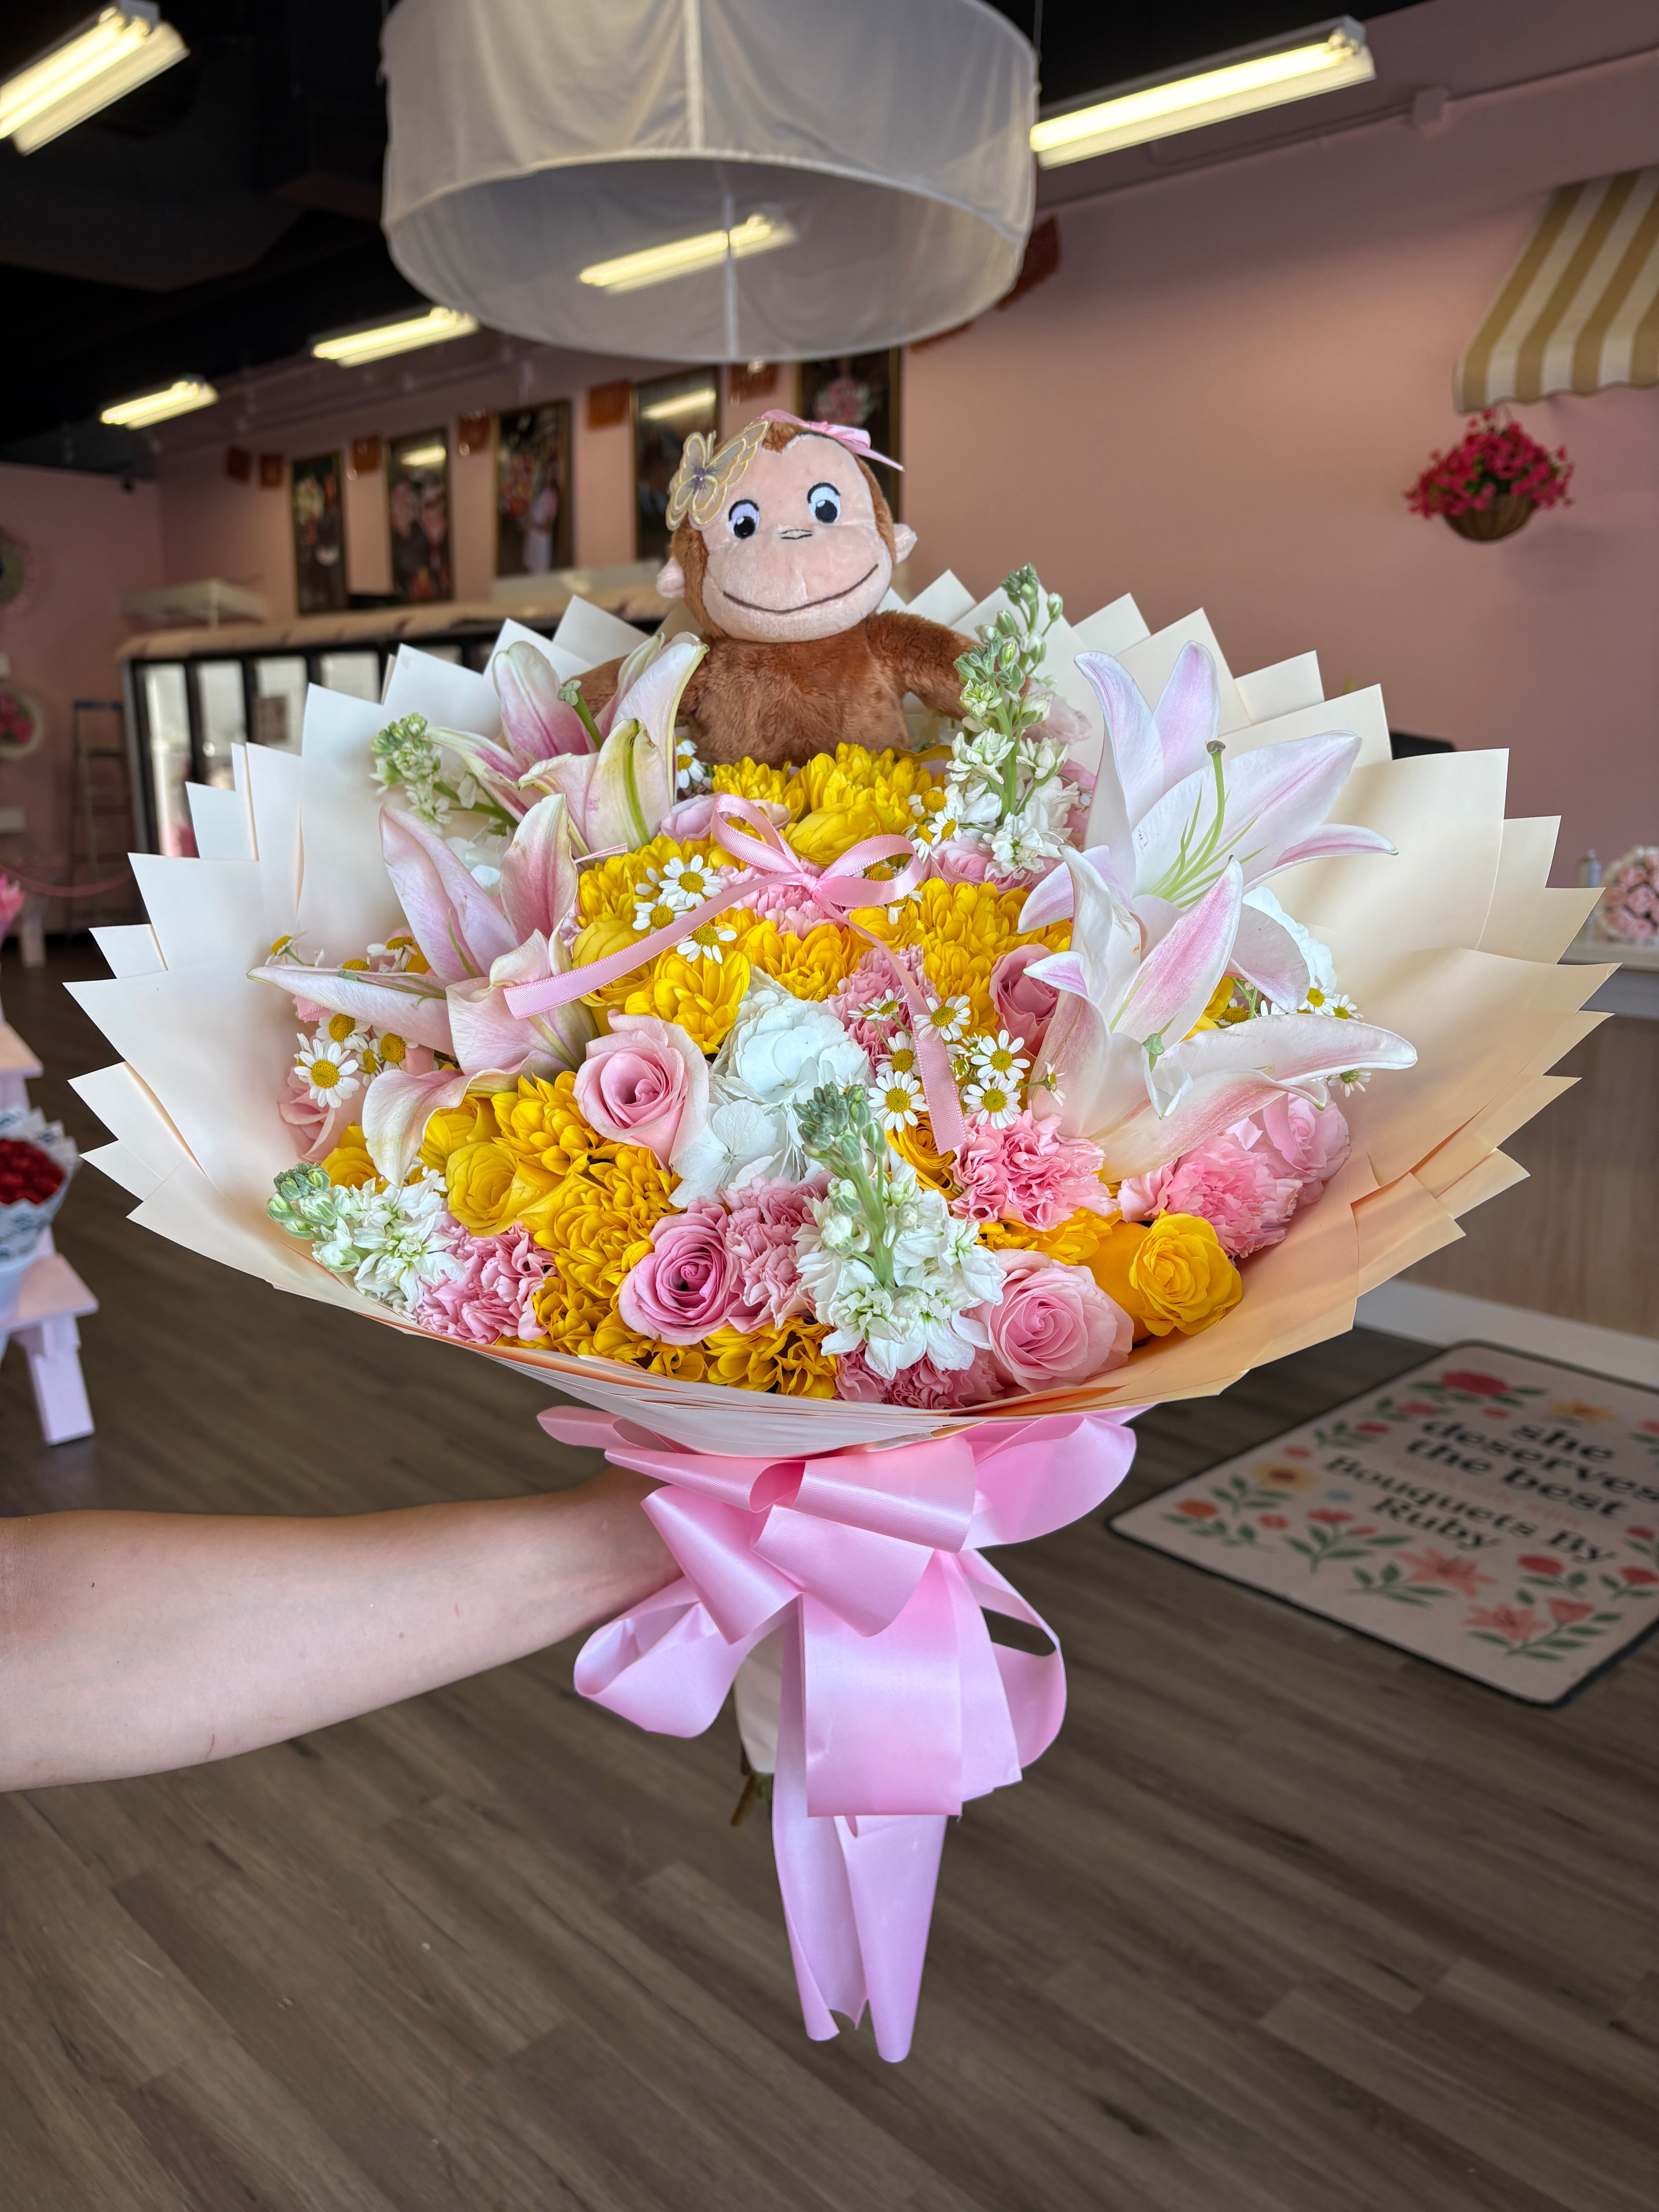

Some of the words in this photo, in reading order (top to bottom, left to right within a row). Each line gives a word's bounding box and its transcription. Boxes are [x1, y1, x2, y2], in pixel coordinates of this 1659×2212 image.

[1405, 1438, 1493, 1475] the
[1499, 1467, 1626, 1518] best
[1421, 1420, 1659, 1503] deserves
[1511, 1424, 1615, 1463] she
[1322, 1455, 1539, 1538] Bouquets
[1544, 1529, 1620, 1564] By
[1368, 1496, 1503, 1550] Ruby
